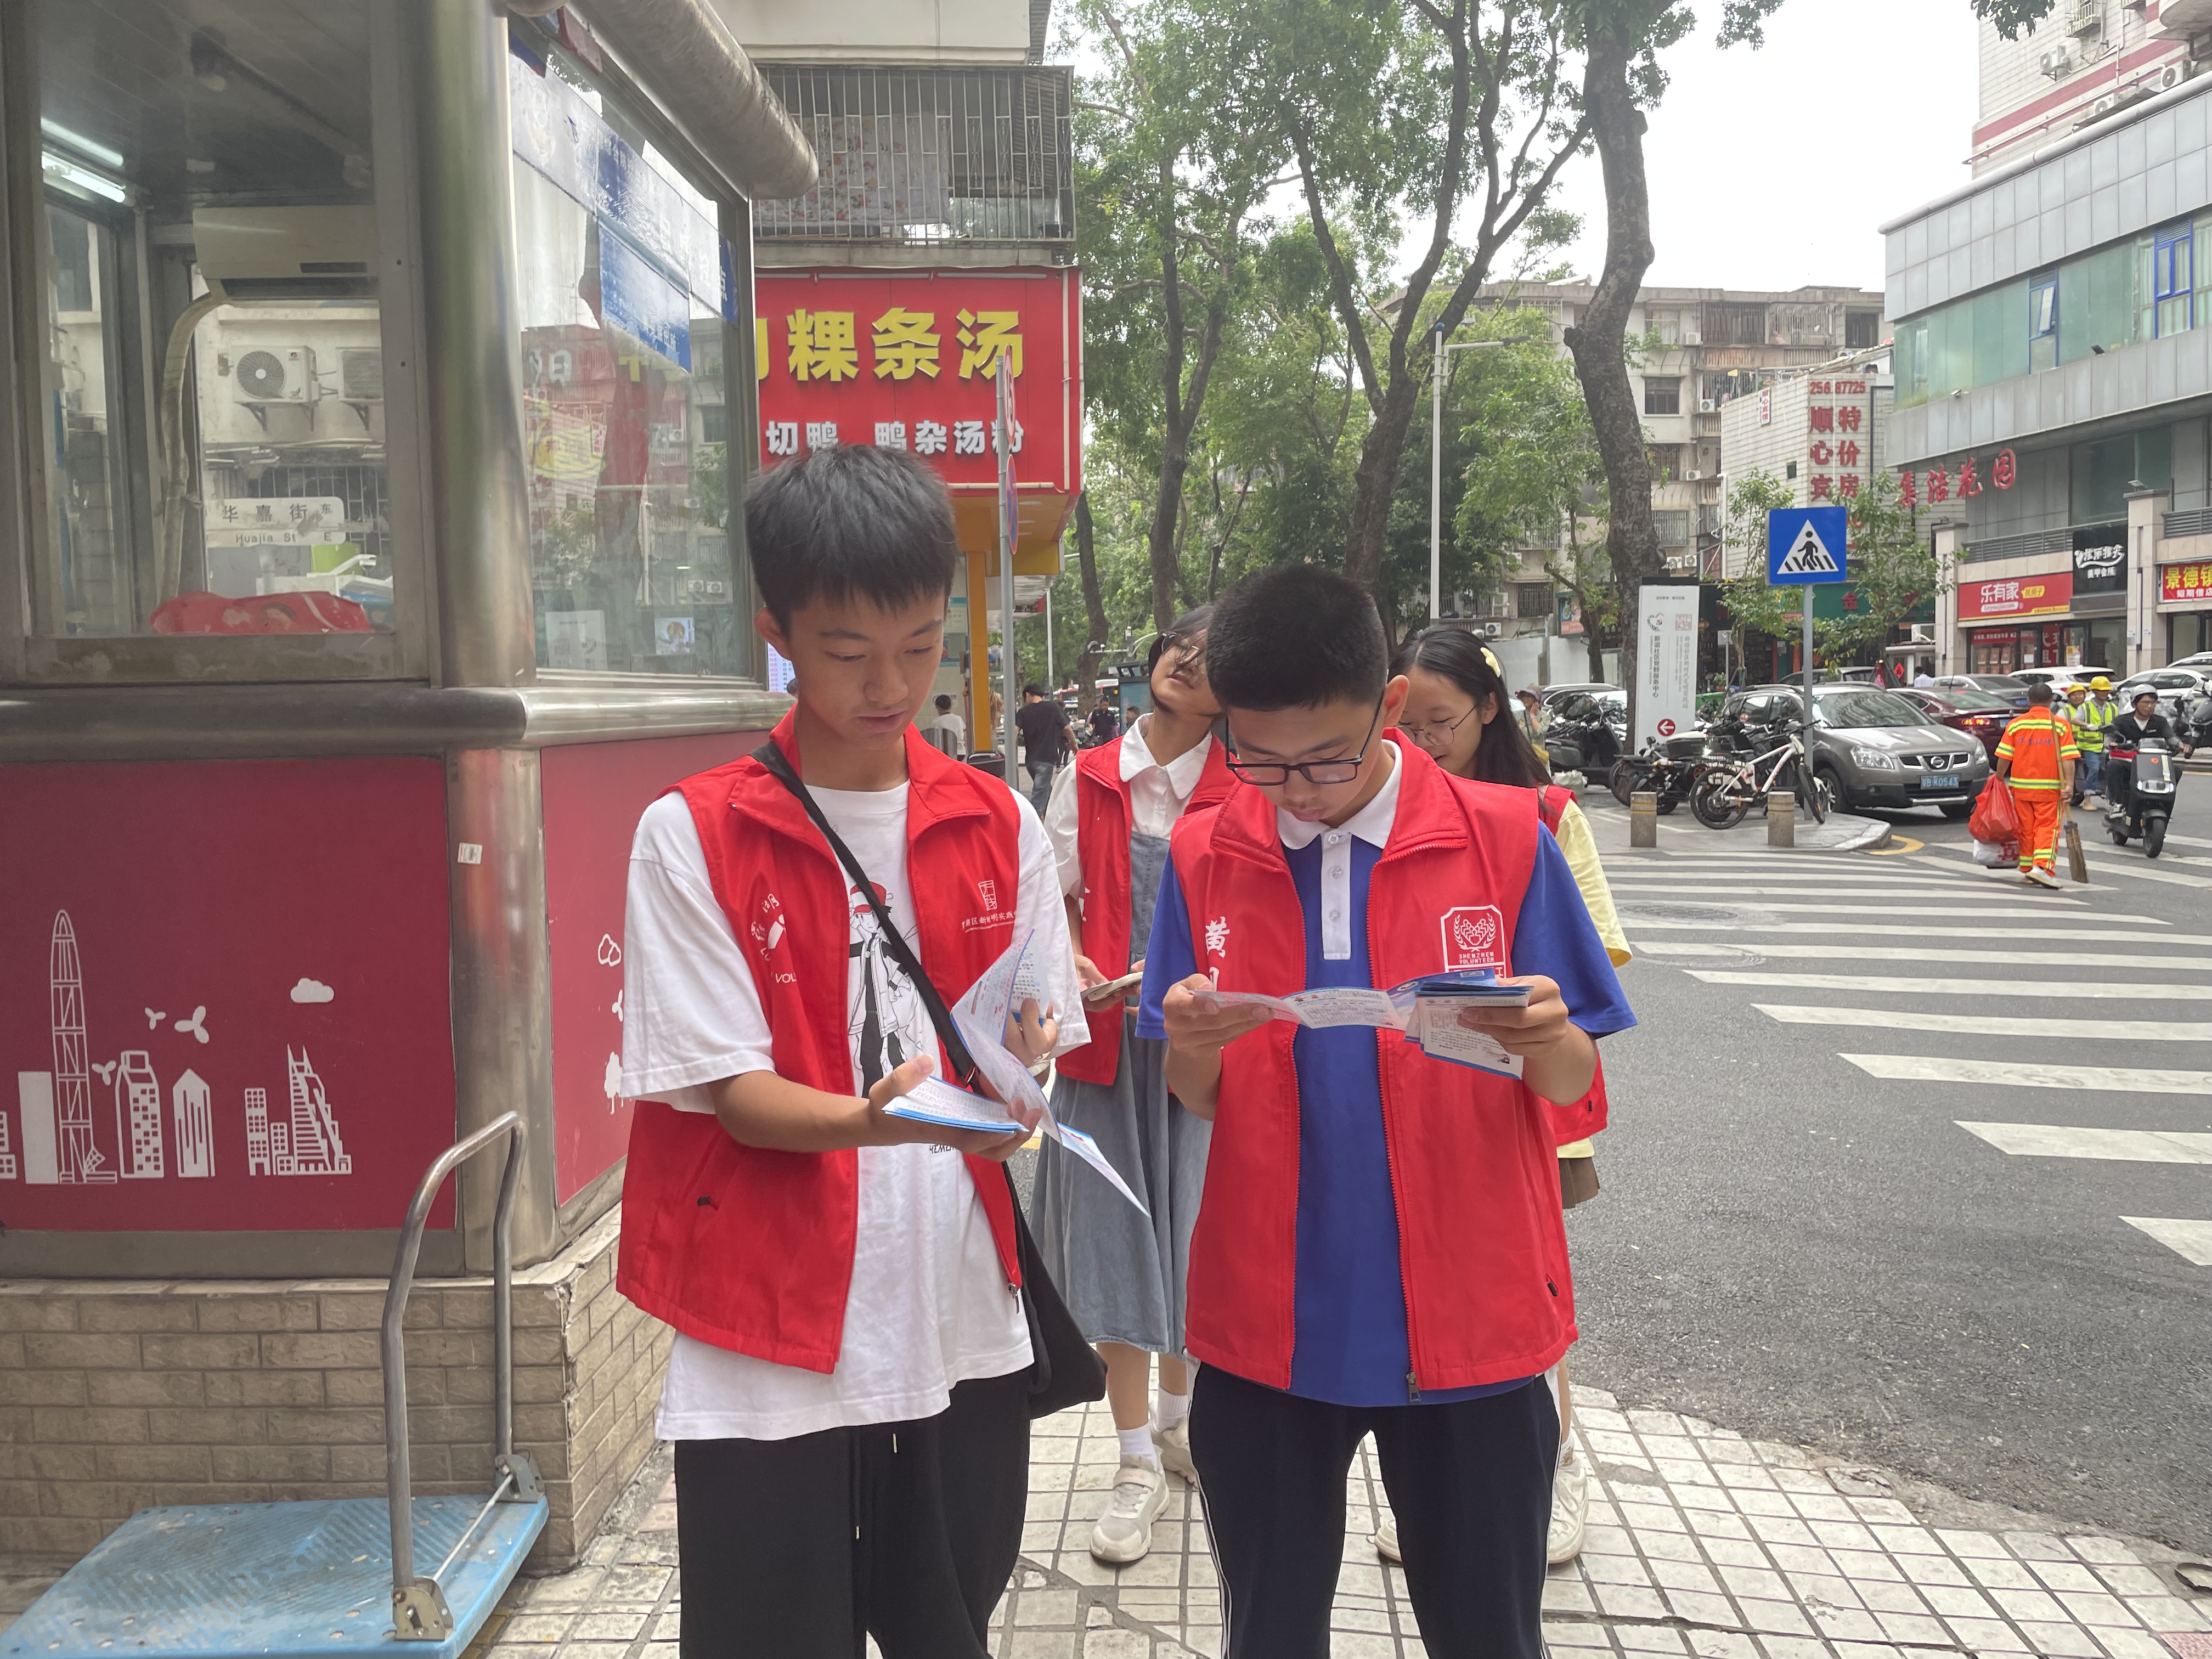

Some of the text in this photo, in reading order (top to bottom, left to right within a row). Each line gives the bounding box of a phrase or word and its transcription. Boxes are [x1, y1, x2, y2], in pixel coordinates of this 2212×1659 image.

[236, 532, 273, 545] Huajia
[324, 532, 332, 541] E
[1980, 582, 2019, 603] 乐有家
[1459, 951, 1494, 960] SHENZHEN
